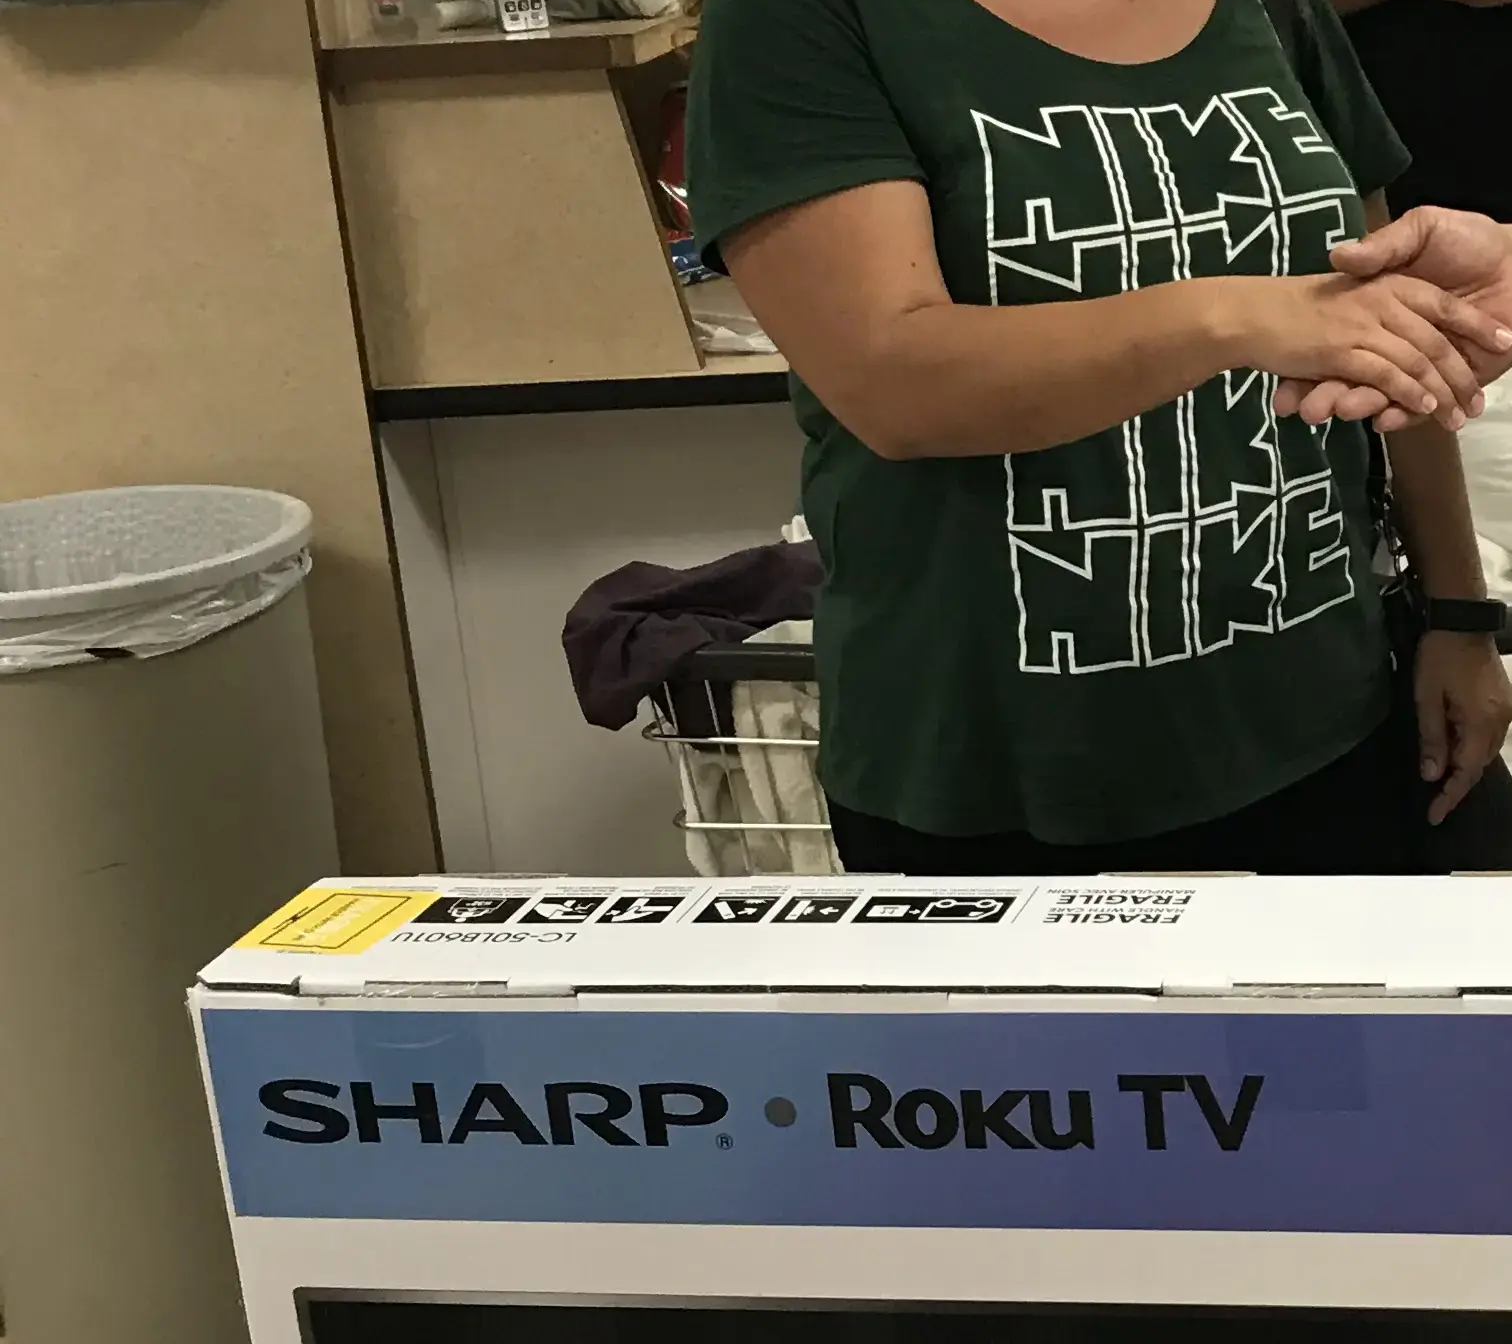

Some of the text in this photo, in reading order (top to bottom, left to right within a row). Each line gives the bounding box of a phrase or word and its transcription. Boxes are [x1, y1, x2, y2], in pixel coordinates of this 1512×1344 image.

[971, 88, 1356, 248] NIKE
[1009, 479, 1356, 675] NIKE
[1043, 913, 1182, 925] FRAGILE
[1056, 894, 1192, 905] FRAGILE
[391, 930, 576, 945] LC-50LB601U
[258, 1072, 1265, 1152] SHARP Roku TV
